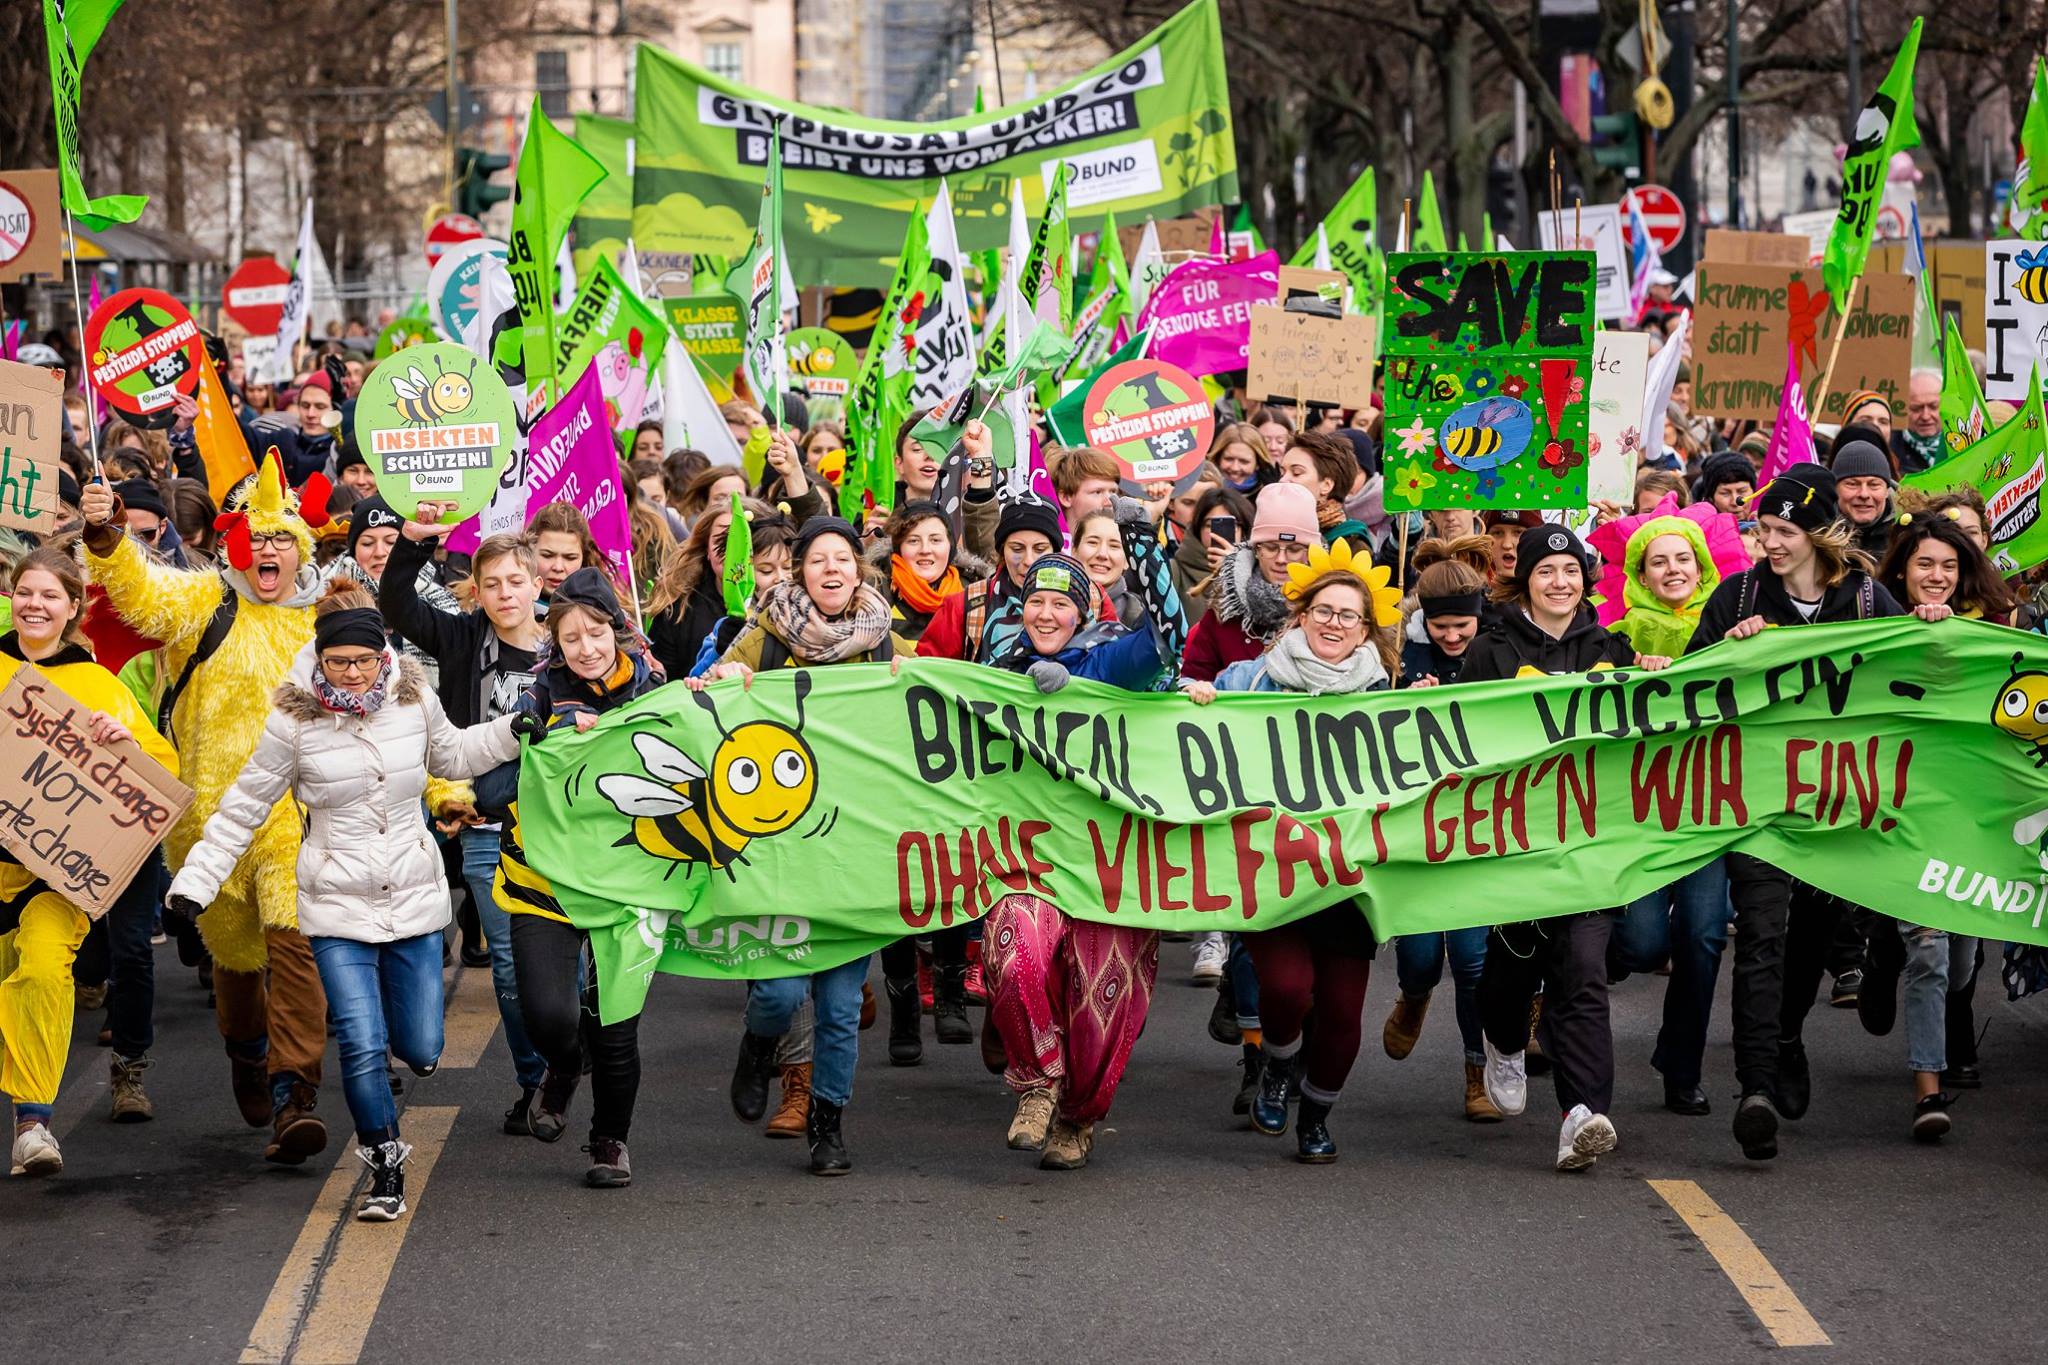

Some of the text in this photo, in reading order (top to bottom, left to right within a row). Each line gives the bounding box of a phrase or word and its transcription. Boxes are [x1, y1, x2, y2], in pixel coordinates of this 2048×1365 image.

[712, 58, 1147, 151] GLYPHOSAT UND CO
[747, 100, 1127, 177] BEIBT UNS VOM ACKER!
[1082, 157, 1136, 180] BUND
[1182, 280, 1221, 306] FÜR
[1699, 269, 1787, 312] krumme
[1993, 252, 2012, 306] I
[673, 306, 738, 325] KLASSE
[1396, 260, 1591, 350] SAVE
[93, 319, 197, 386] PESTIZIDE STOPPEN!
[683, 323, 735, 340] STATT
[1707, 320, 1769, 355] statt
[1986, 318, 2019, 383] I
[1401, 356, 1457, 402] the
[1593, 346, 1621, 374] te
[151, 390, 171, 401] BUND
[376, 426, 494, 451] INSEKTEN
[1090, 401, 1210, 446] PESTIZIDE STOPPEN!
[386, 451, 488, 472] SCHÜTZEN!
[427, 475, 454, 484] BUND
[8, 685, 169, 836] System change
[1177, 700, 1479, 816] BLUMEN
[21, 750, 103, 816] NOT
[897, 815, 1057, 928] OHNE
[1087, 803, 1390, 919] VIELFALT
[1630, 723, 1749, 833] WIR
[1785, 735, 1914, 834] EIN!
[30, 824, 110, 900] change
[670, 912, 811, 950] UND
